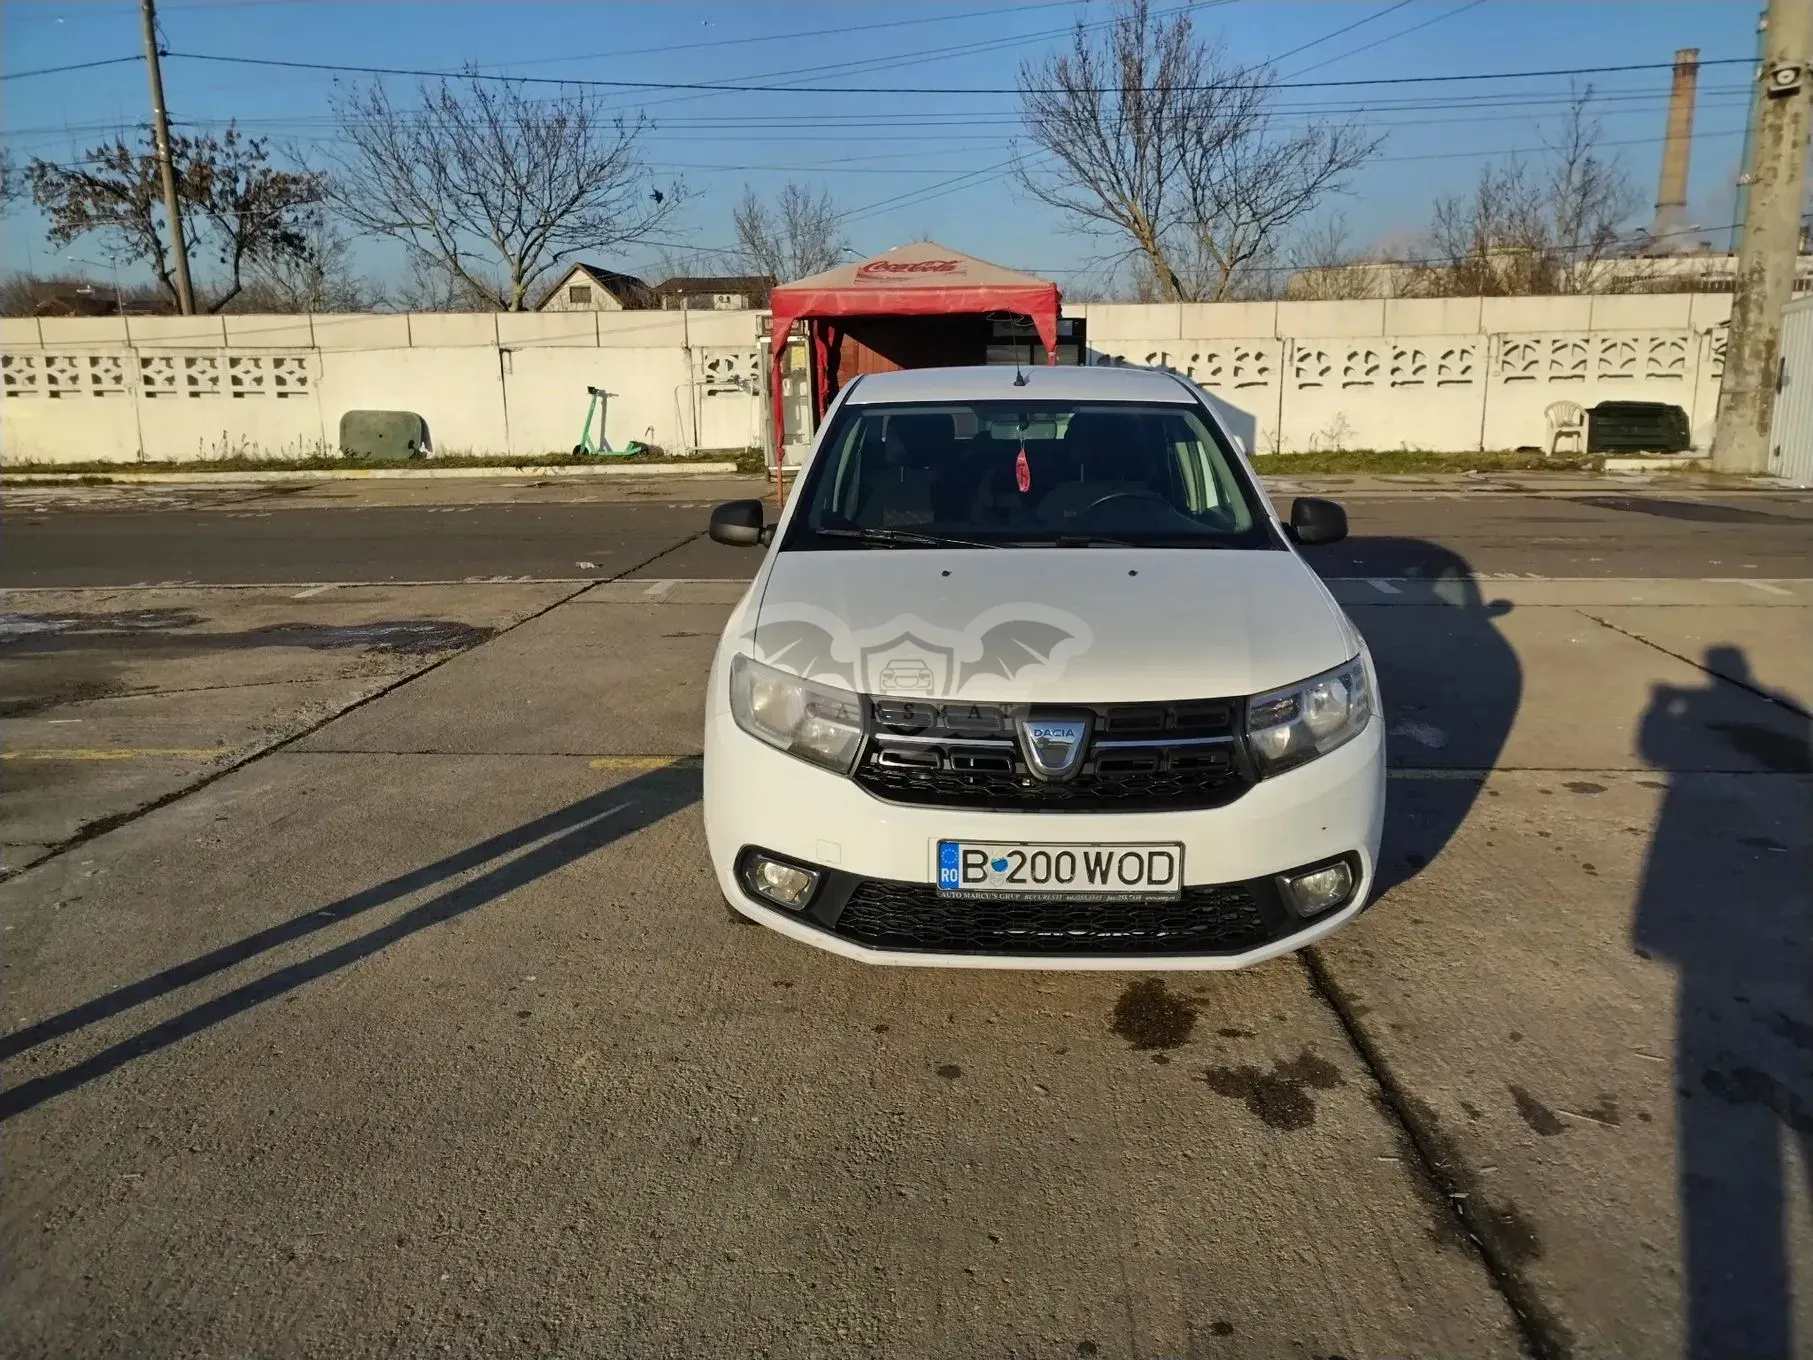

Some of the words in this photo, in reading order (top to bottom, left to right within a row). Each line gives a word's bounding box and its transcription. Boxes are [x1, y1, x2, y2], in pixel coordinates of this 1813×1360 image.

[1034, 729, 1075, 737] DACIA
[941, 868, 958, 882] RO
[962, 850, 989, 884] B
[1006, 850, 1077, 885] 200
[1084, 851, 1175, 886] WOD
